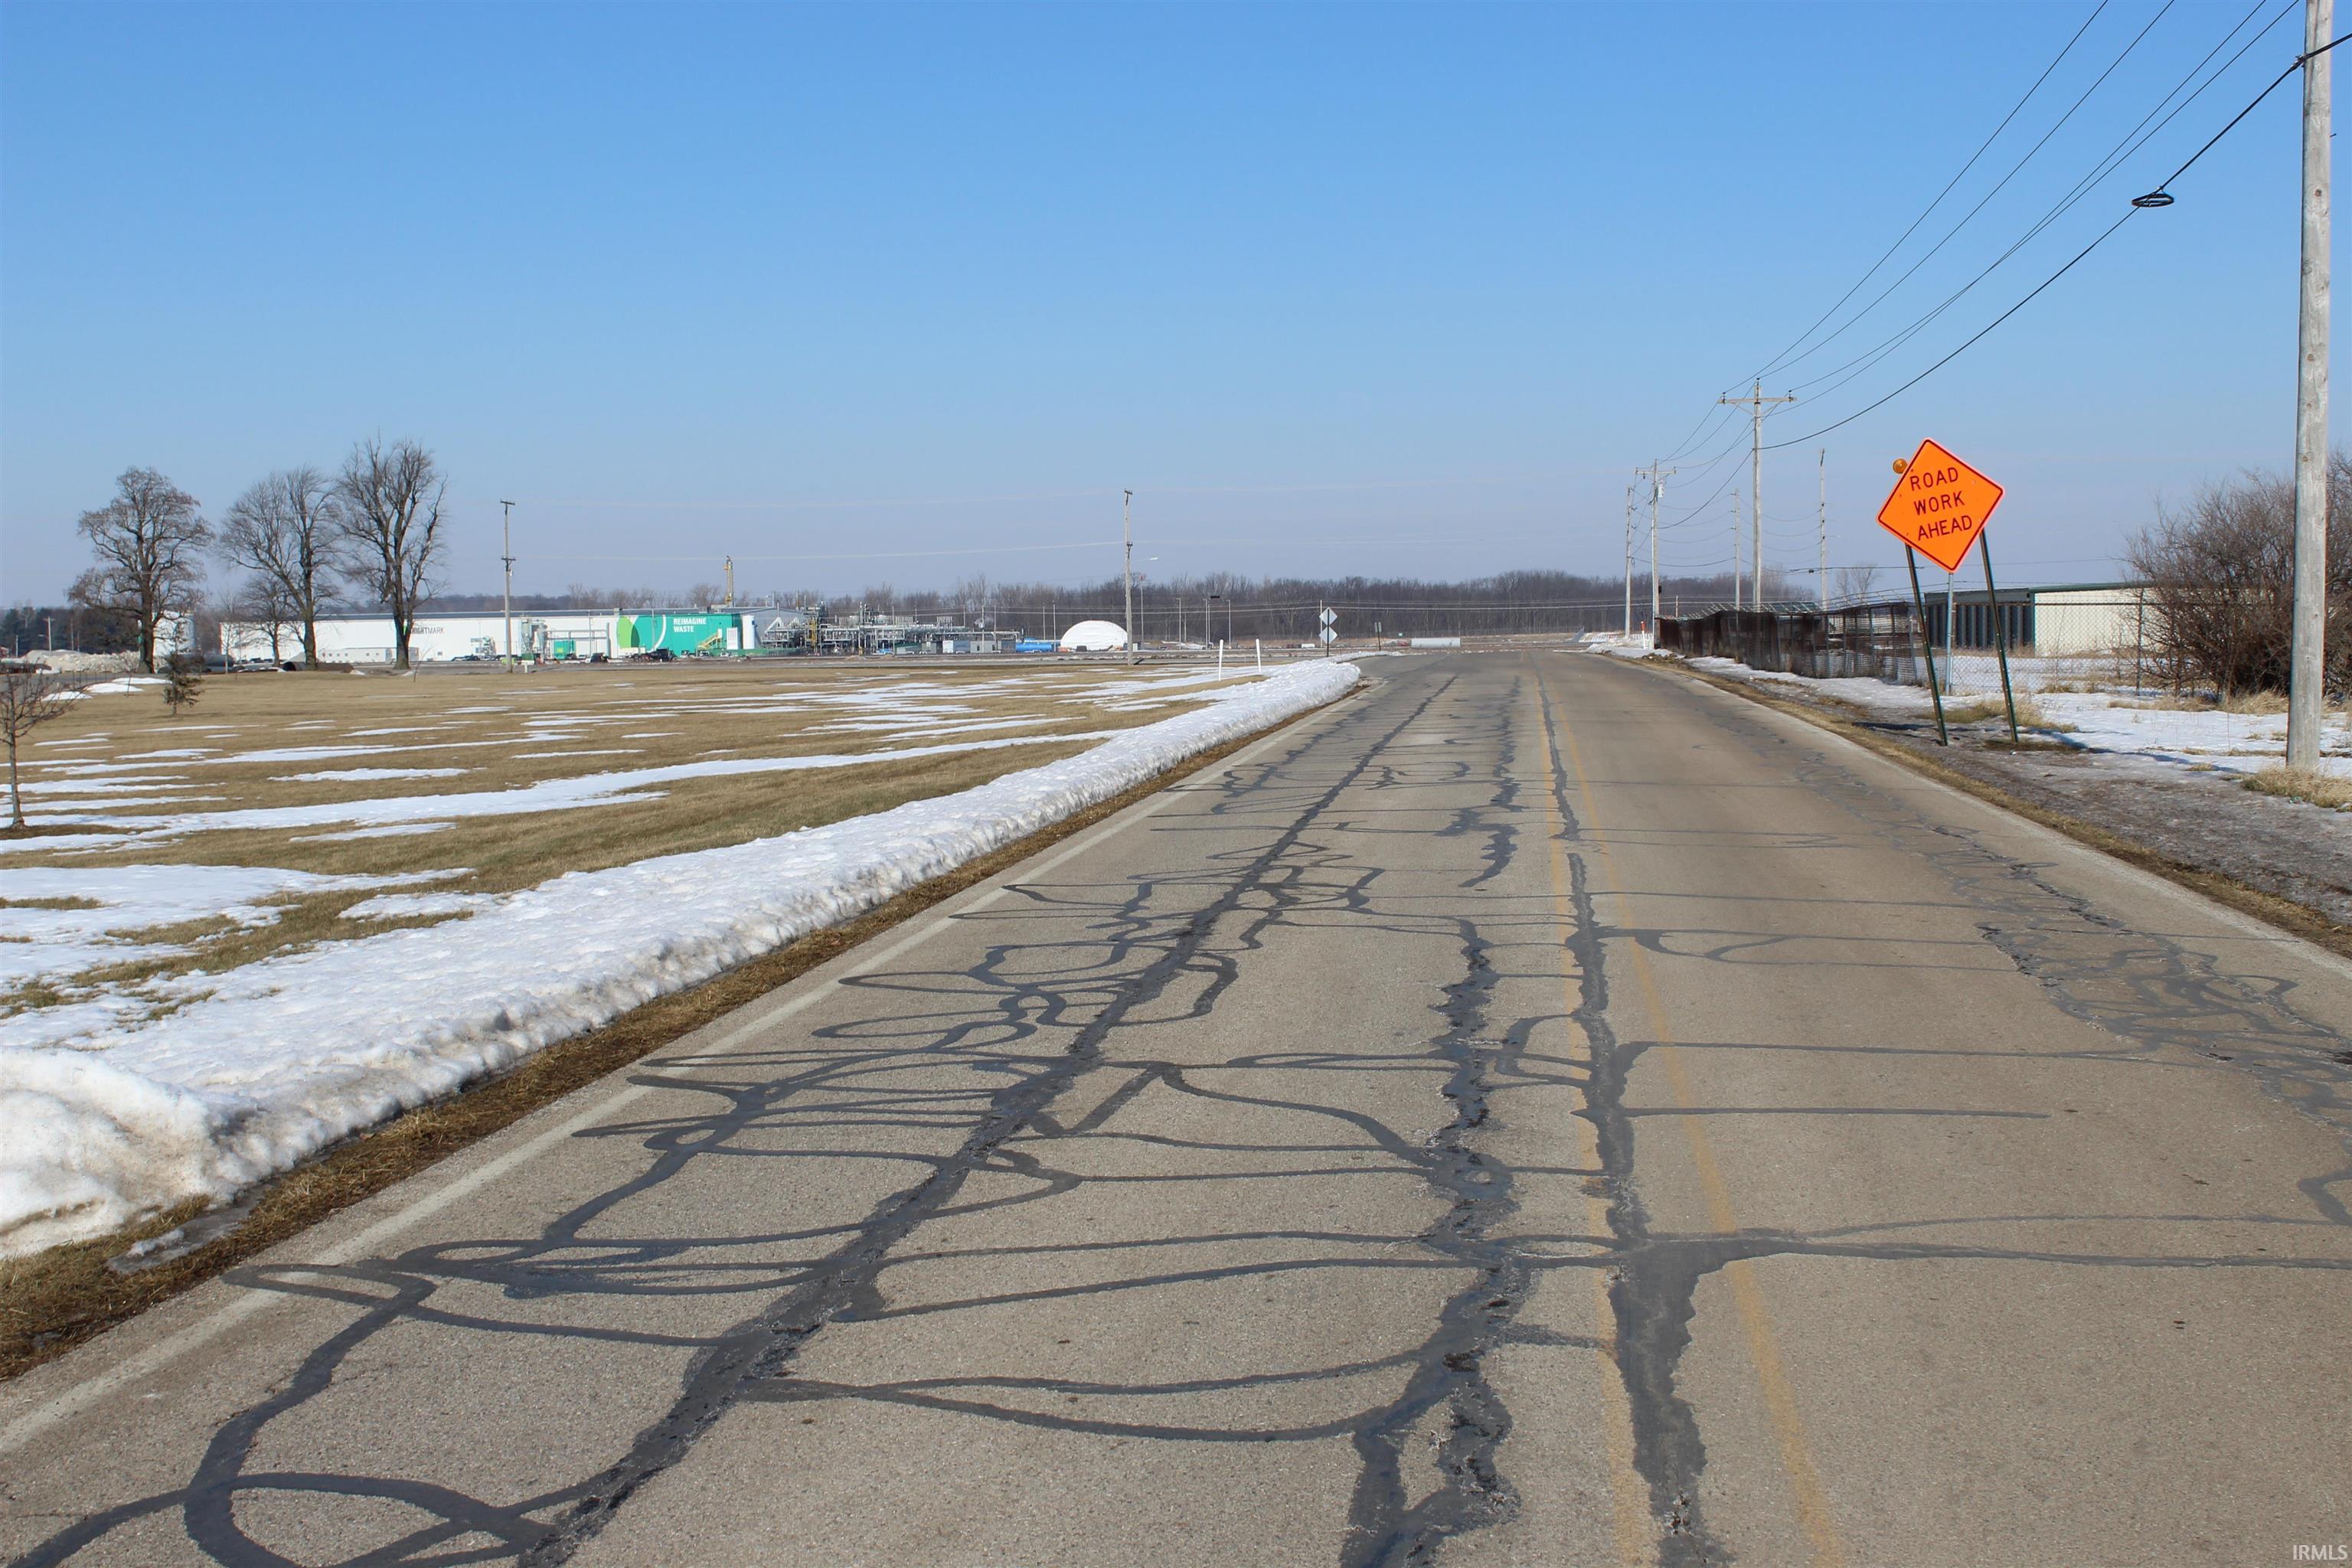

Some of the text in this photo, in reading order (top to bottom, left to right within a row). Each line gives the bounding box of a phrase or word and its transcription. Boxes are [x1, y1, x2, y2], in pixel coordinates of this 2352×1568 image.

[1910, 467, 1958, 491] ROAD
[1914, 491, 1965, 515] WORK
[1918, 515, 1972, 541] AHEAD
